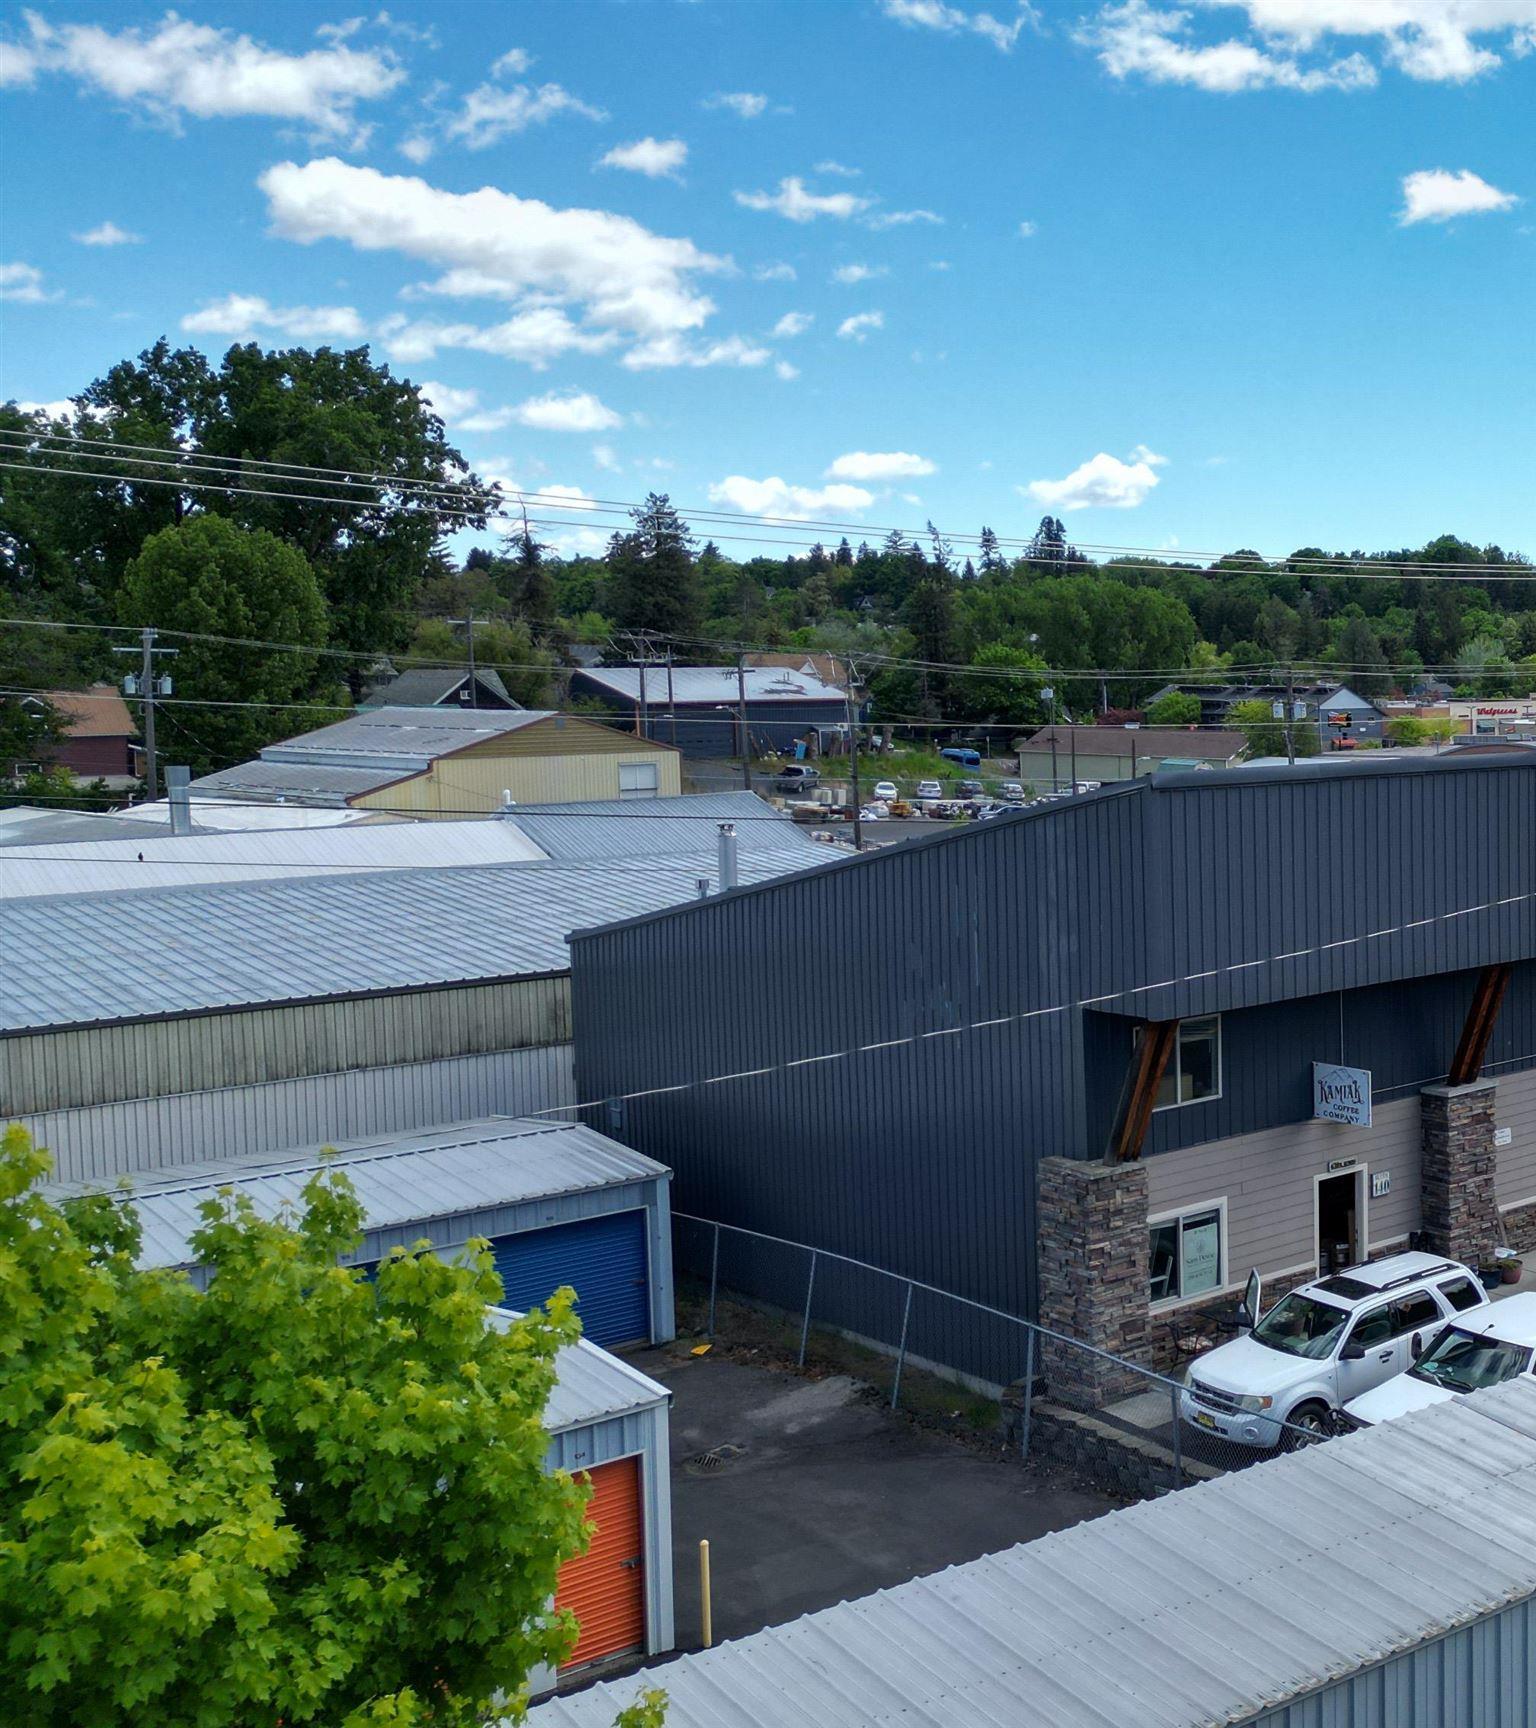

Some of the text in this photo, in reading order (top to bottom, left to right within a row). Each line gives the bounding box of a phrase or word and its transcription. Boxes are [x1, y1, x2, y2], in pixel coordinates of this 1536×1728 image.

[1318, 1080, 1365, 1104] KAMIAK
[1333, 1104, 1359, 1114] COFFEE
[1323, 1110, 1359, 1124] COMPANY
